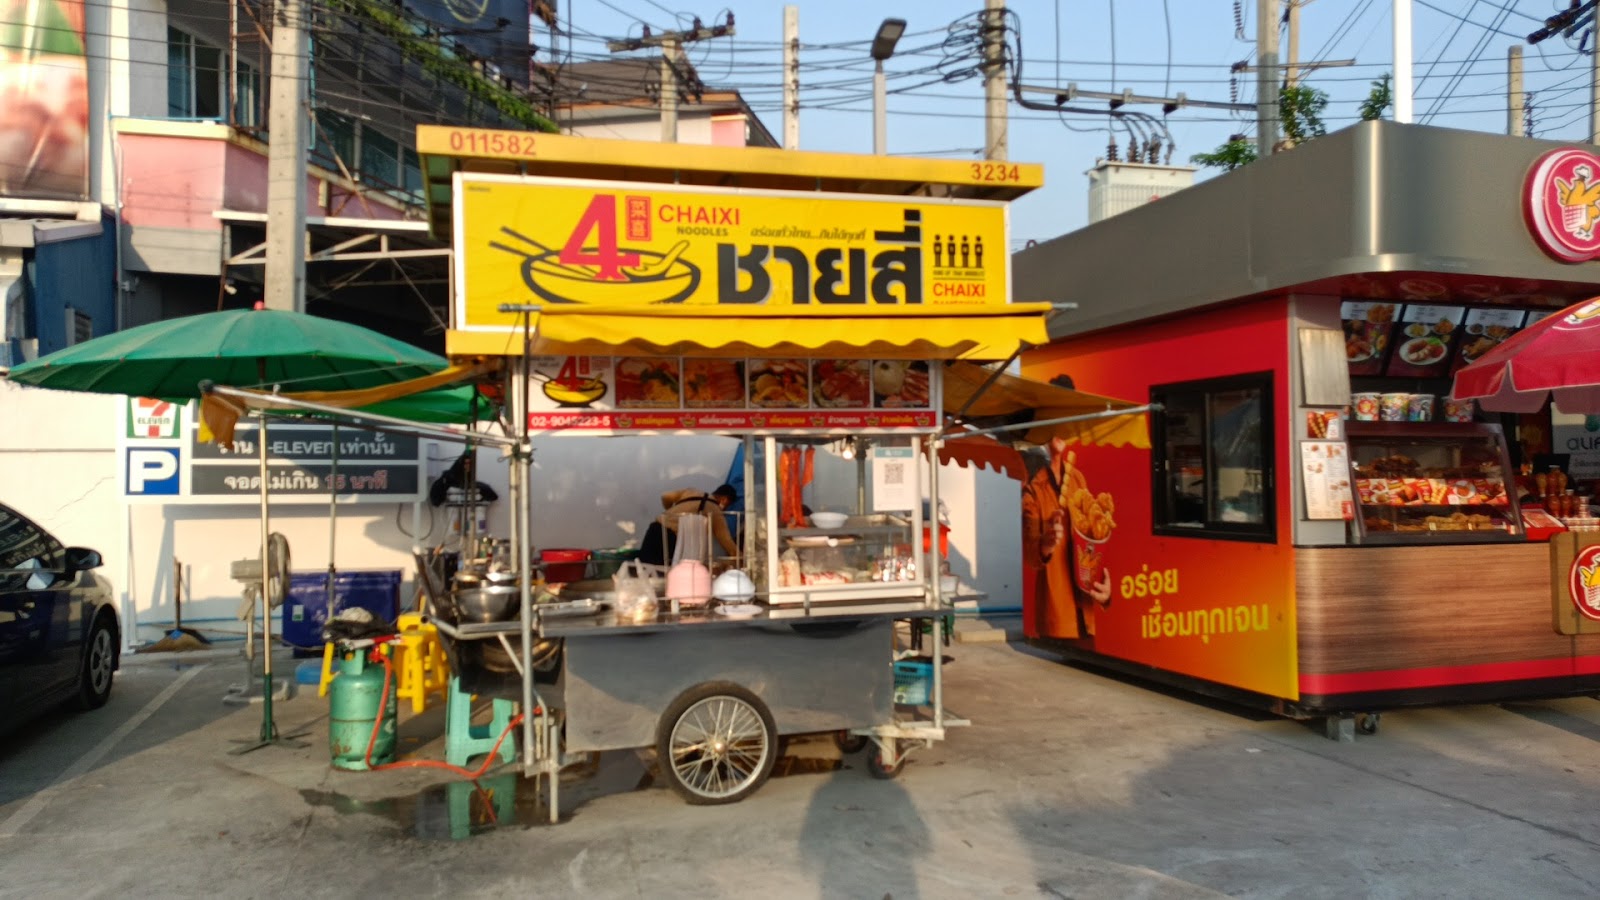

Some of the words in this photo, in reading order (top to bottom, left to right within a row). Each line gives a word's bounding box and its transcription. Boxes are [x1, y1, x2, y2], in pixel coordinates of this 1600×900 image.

[450, 131, 536, 156] 011582
[971, 163, 1020, 182] 3234
[658, 205, 740, 225] CHAIXI
[560, 194, 640, 281] 4
[676, 227, 729, 236] NOODLES
[717, 209, 922, 304] ชายสี่
[933, 283, 985, 297] CHAIXI
[138, 397, 171, 437] 7
[130, 450, 178, 492] P
[349, 470, 388, 490] นาที
[1120, 564, 1178, 599] อร่อย
[1142, 599, 1269, 643] เชื่อมทุกเจน
